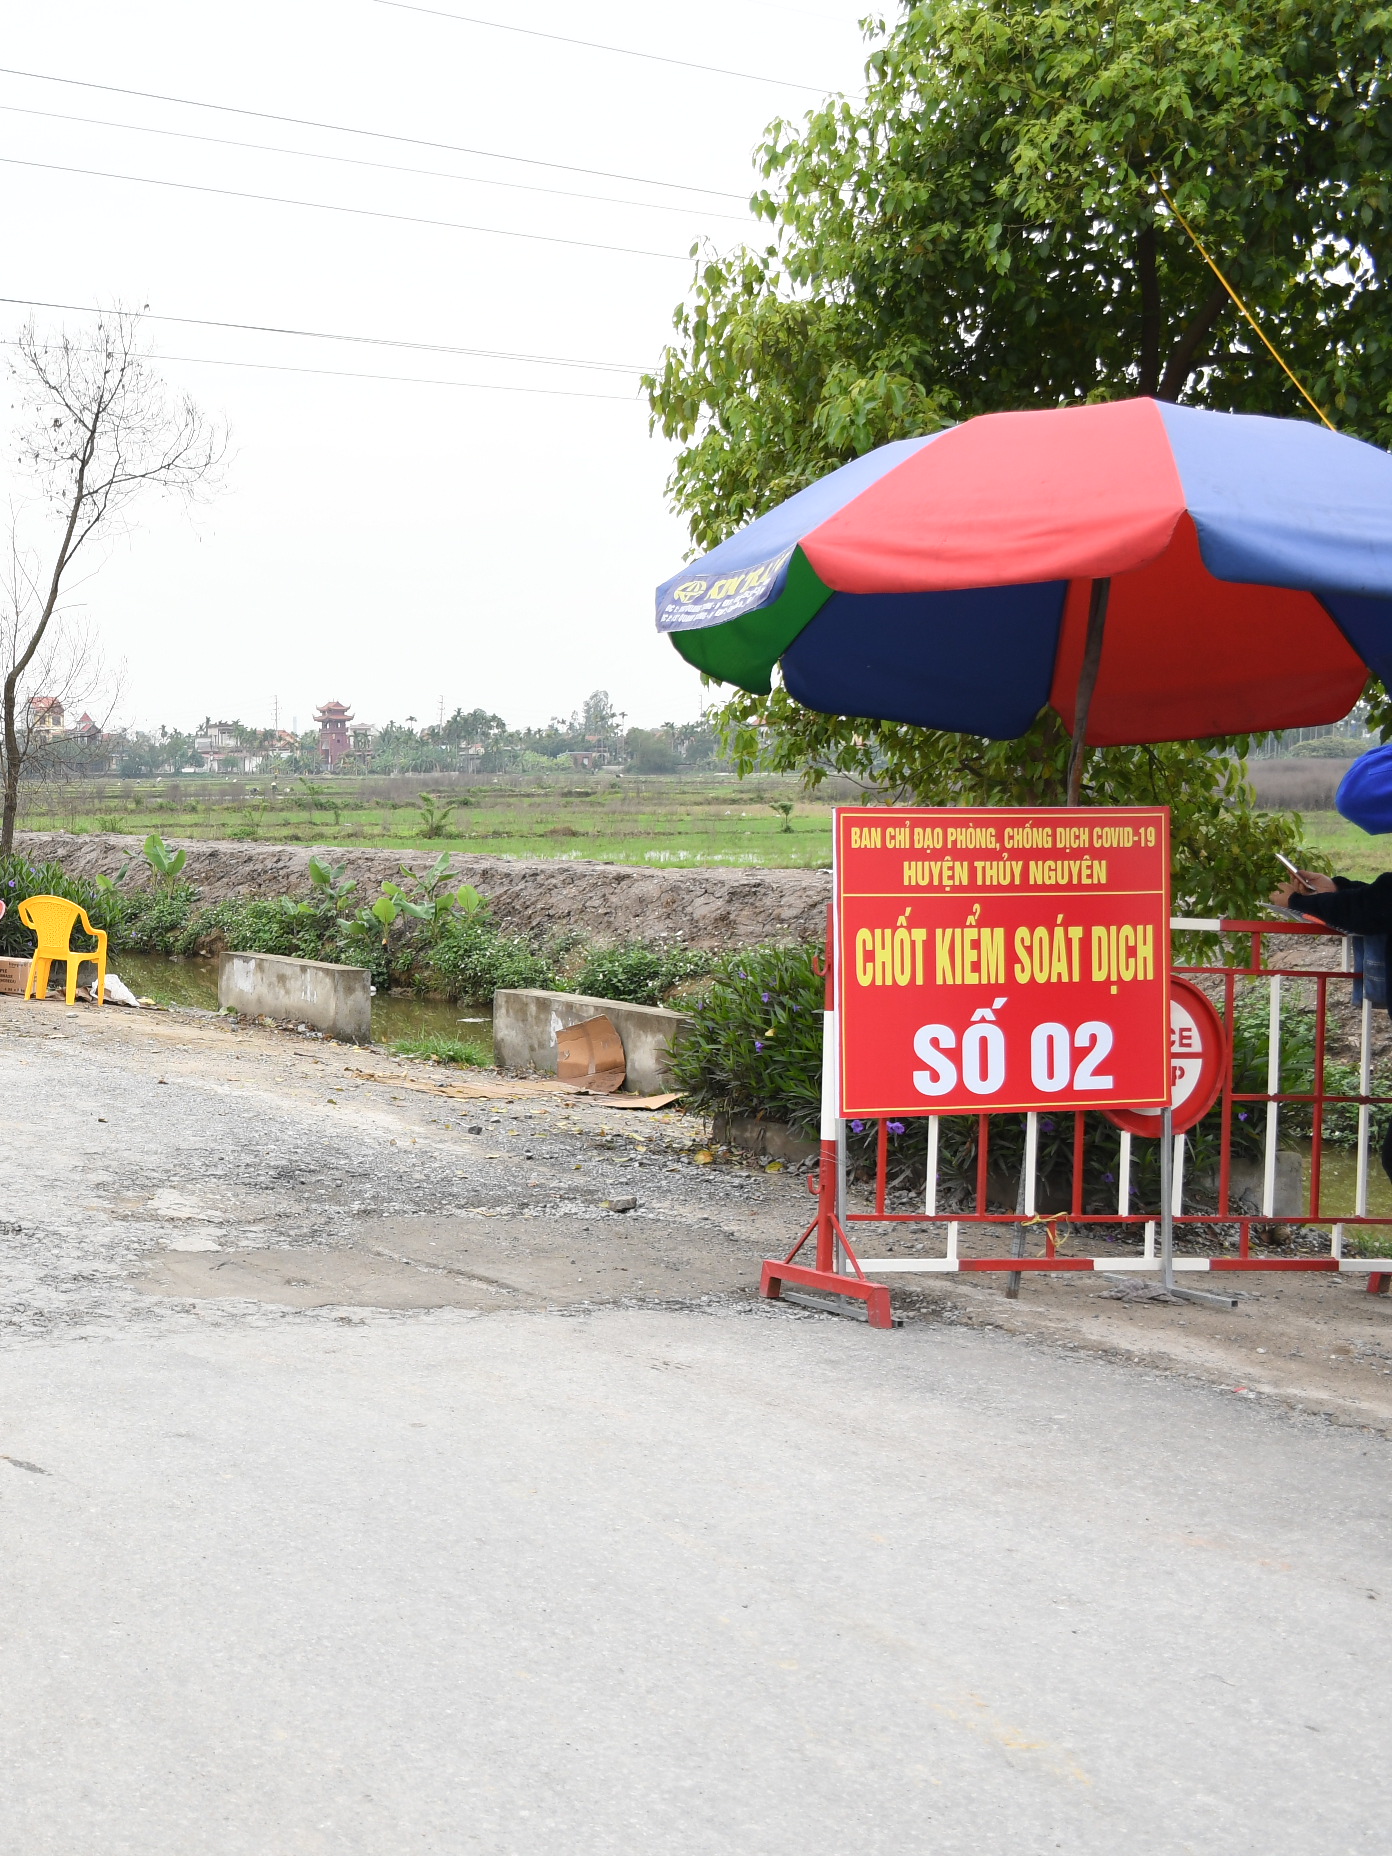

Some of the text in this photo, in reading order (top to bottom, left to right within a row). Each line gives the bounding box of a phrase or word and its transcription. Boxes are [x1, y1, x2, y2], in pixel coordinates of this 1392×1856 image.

[851, 820, 1156, 854] BAN CHỈ ĐẠO PHÒNG, CHỐNG DỊCH COVID-19
[903, 852, 1107, 892] HUYỆN THỦY NGUYÊN
[855, 903, 1154, 995] CHỐT KIỂM SOÁT DỊCH
[912, 997, 1114, 1096] SỐ 02
